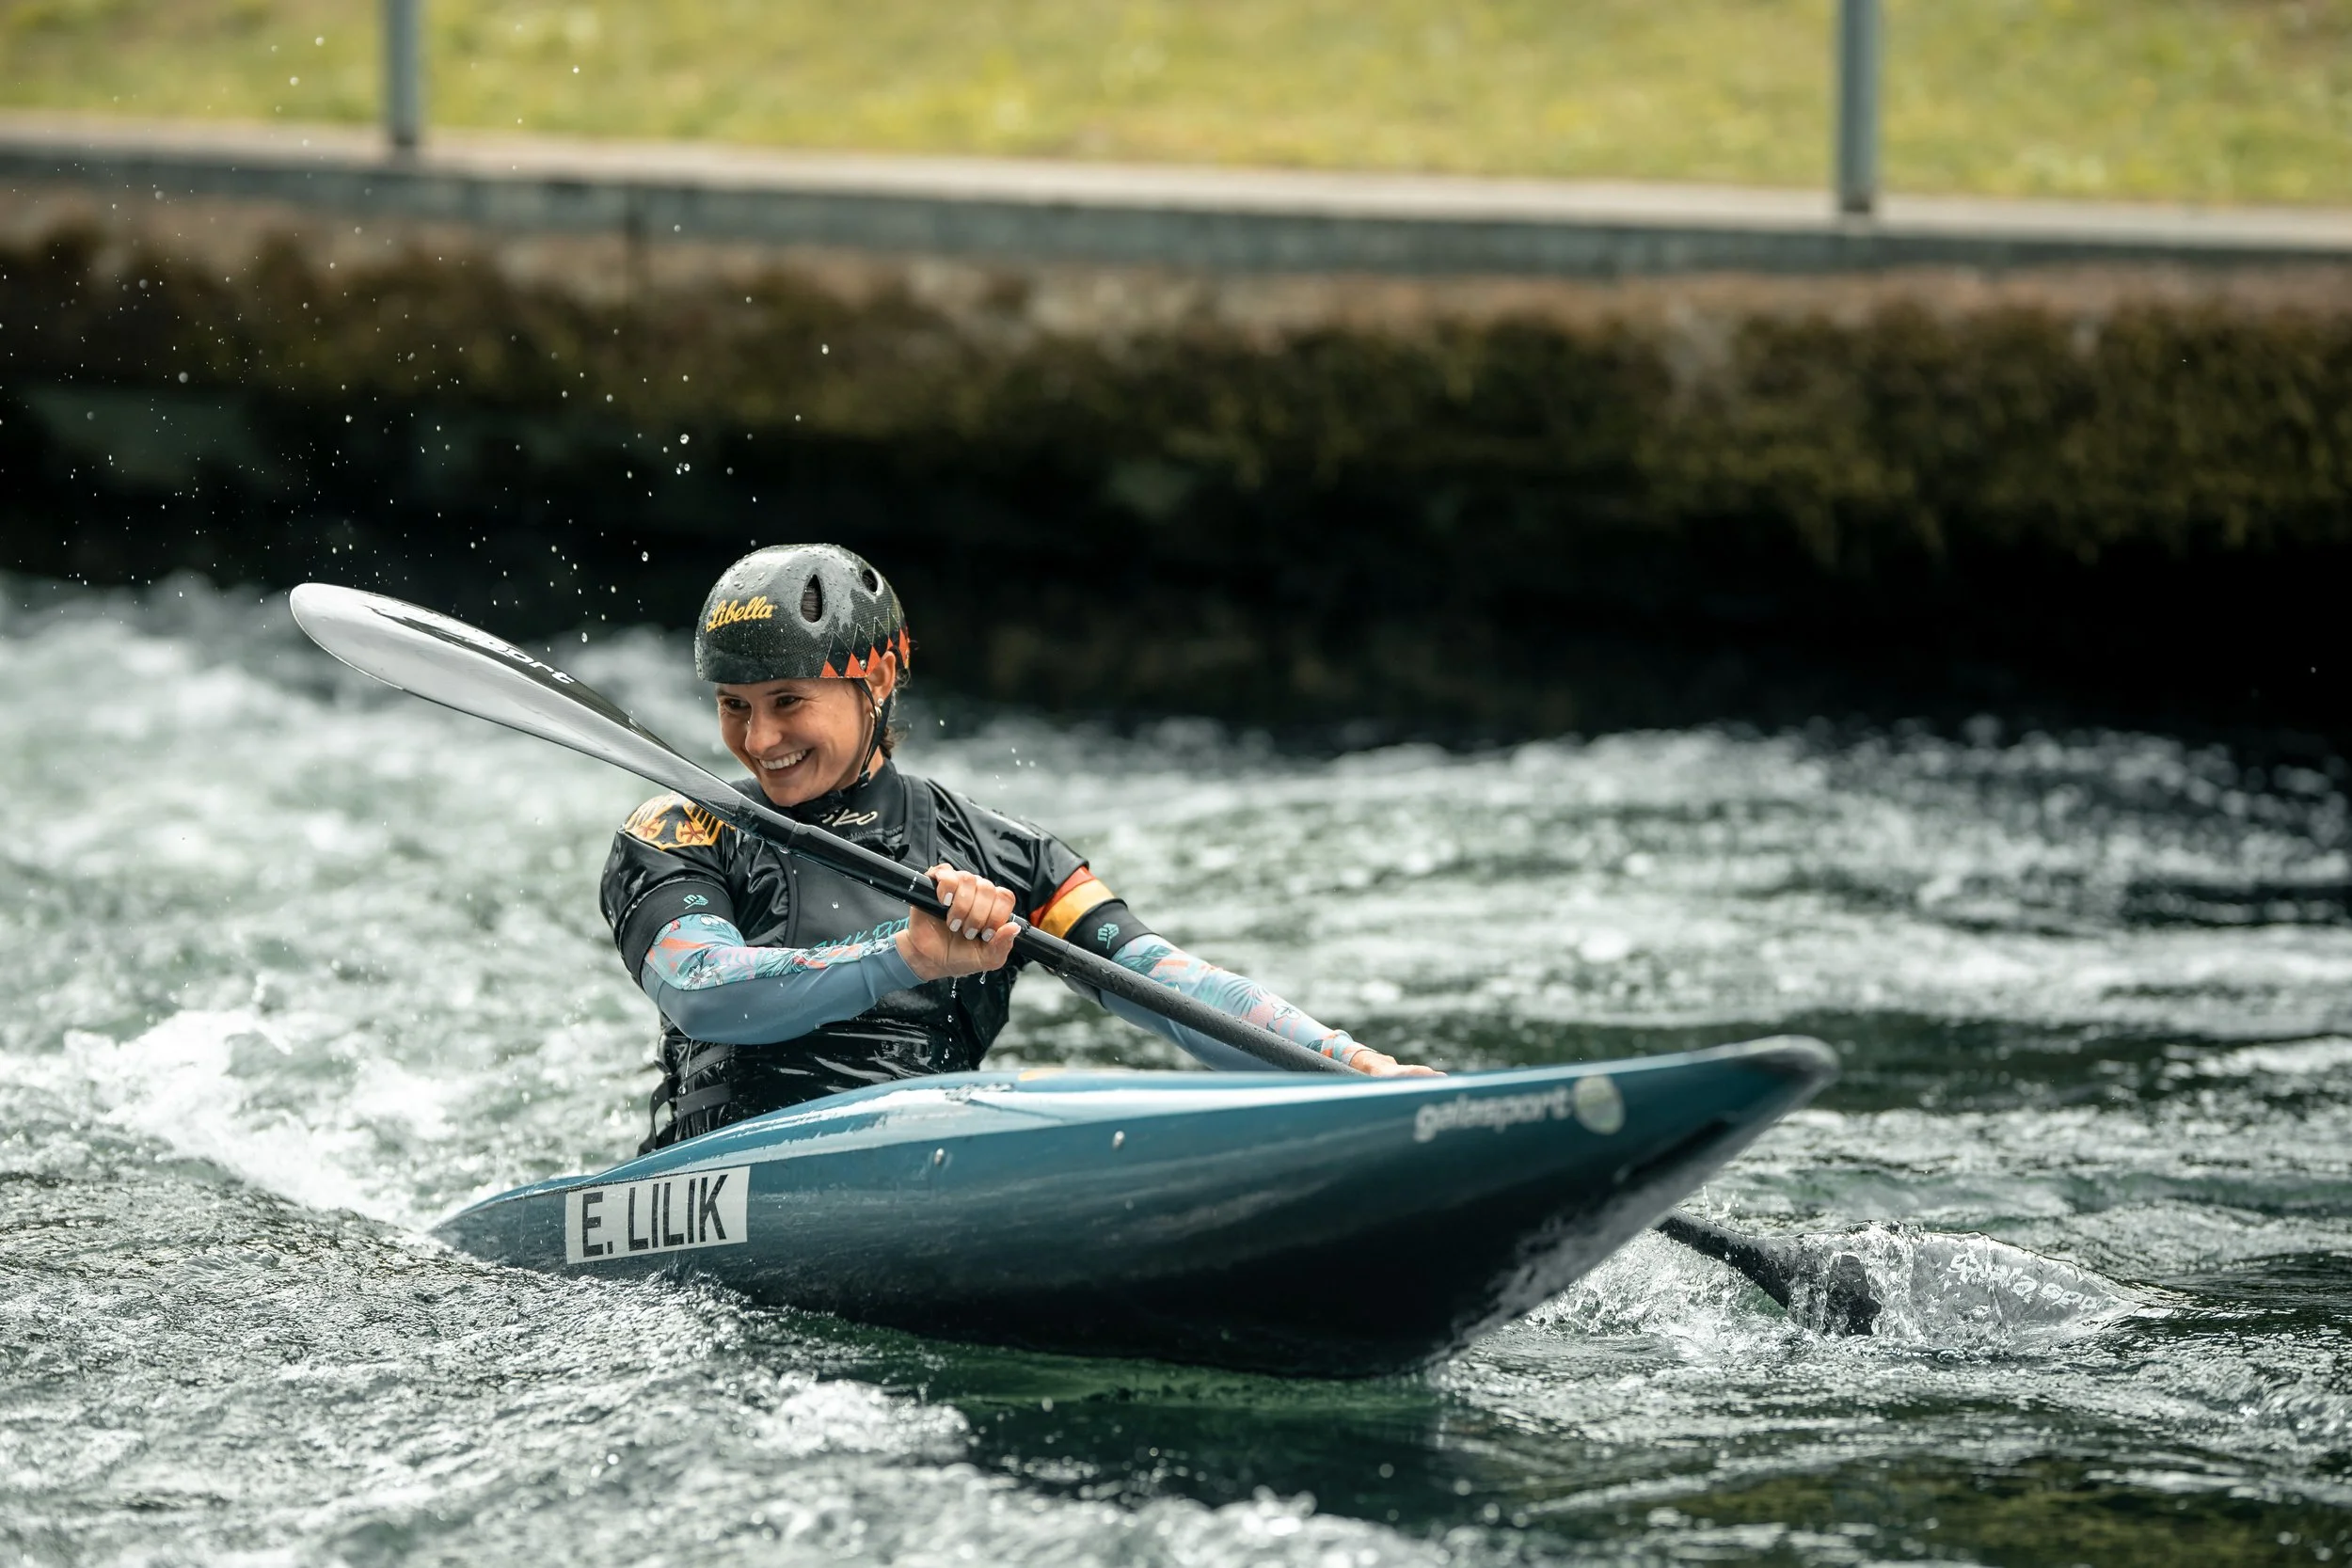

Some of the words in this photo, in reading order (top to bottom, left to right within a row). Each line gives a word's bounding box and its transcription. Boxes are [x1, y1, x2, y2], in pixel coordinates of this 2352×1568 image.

[707, 596, 773, 633] Libella
[582, 1192, 613, 1258] E.
[628, 1174, 728, 1252] LILIK
